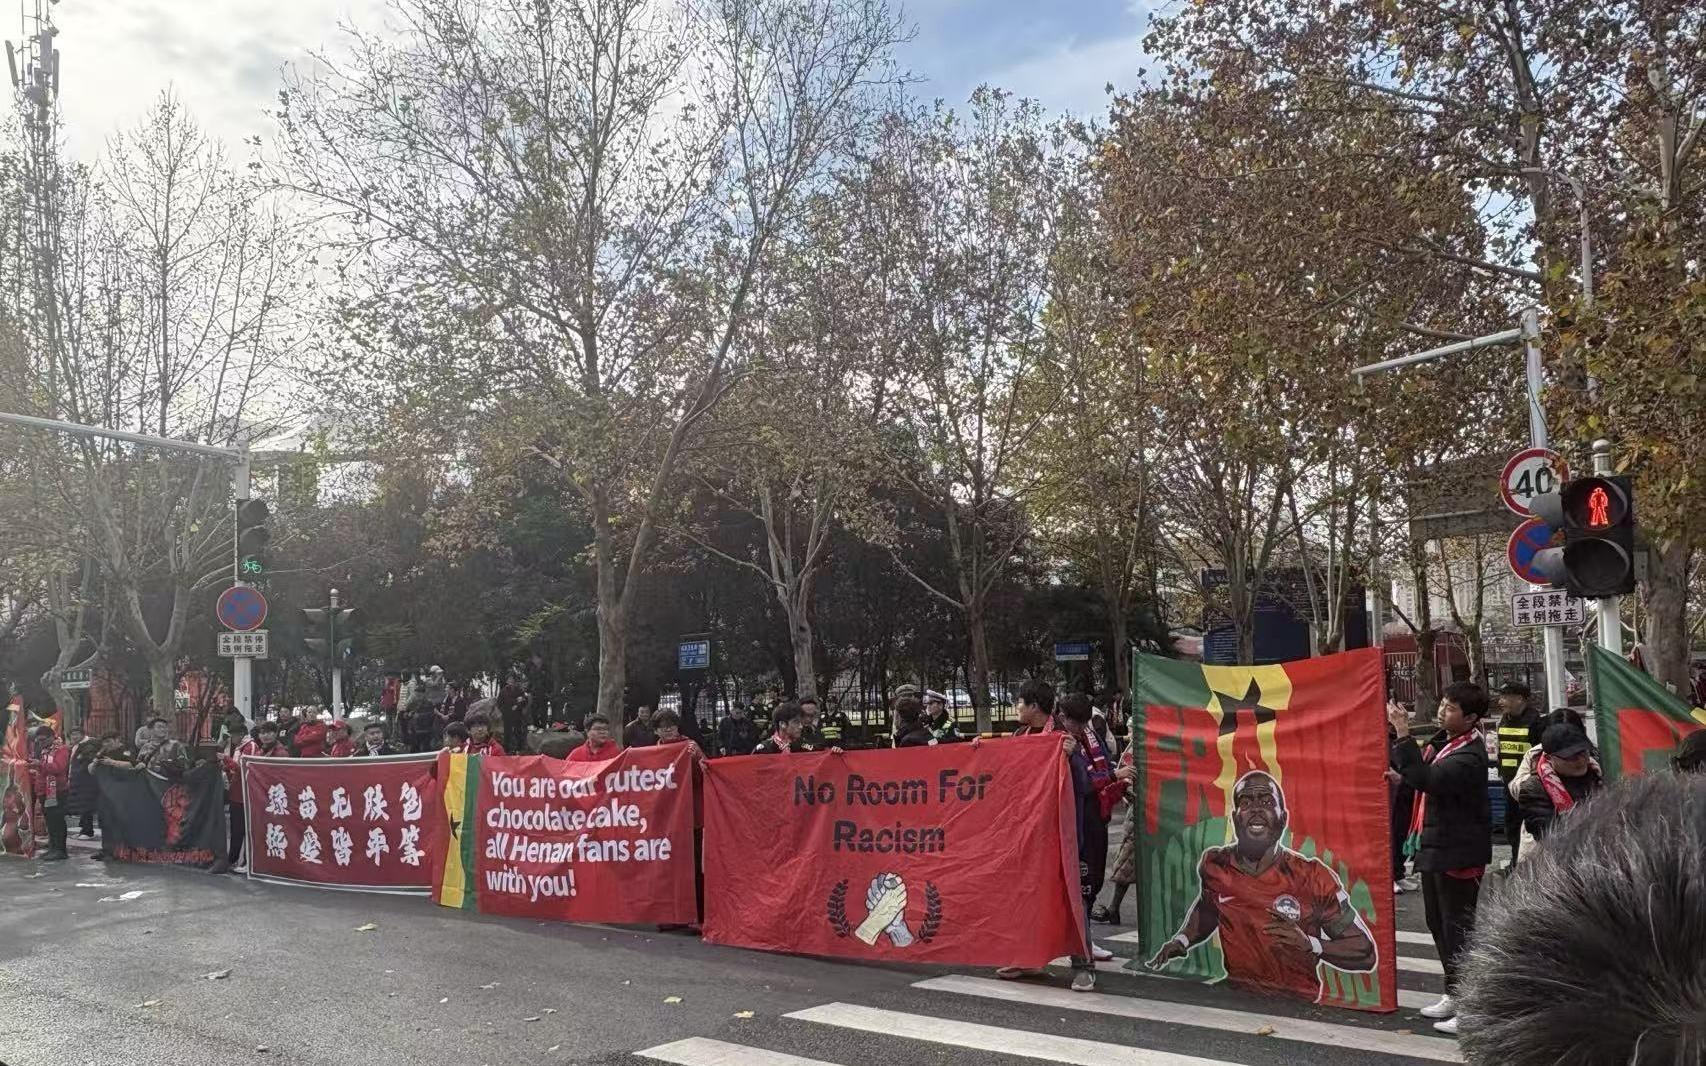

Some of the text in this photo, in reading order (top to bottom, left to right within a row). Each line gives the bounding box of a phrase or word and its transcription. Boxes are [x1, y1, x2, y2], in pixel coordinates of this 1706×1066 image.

[1515, 466, 1553, 498] 40
[1518, 608, 1578, 624] 违例拖走
[491, 763, 677, 799] You are our cutest
[792, 768, 992, 806] No Room For
[486, 798, 647, 833] chocolate cake,
[486, 832, 672, 863] all Henan fans are
[833, 819, 946, 853] Racism
[486, 864, 577, 901] with you!
